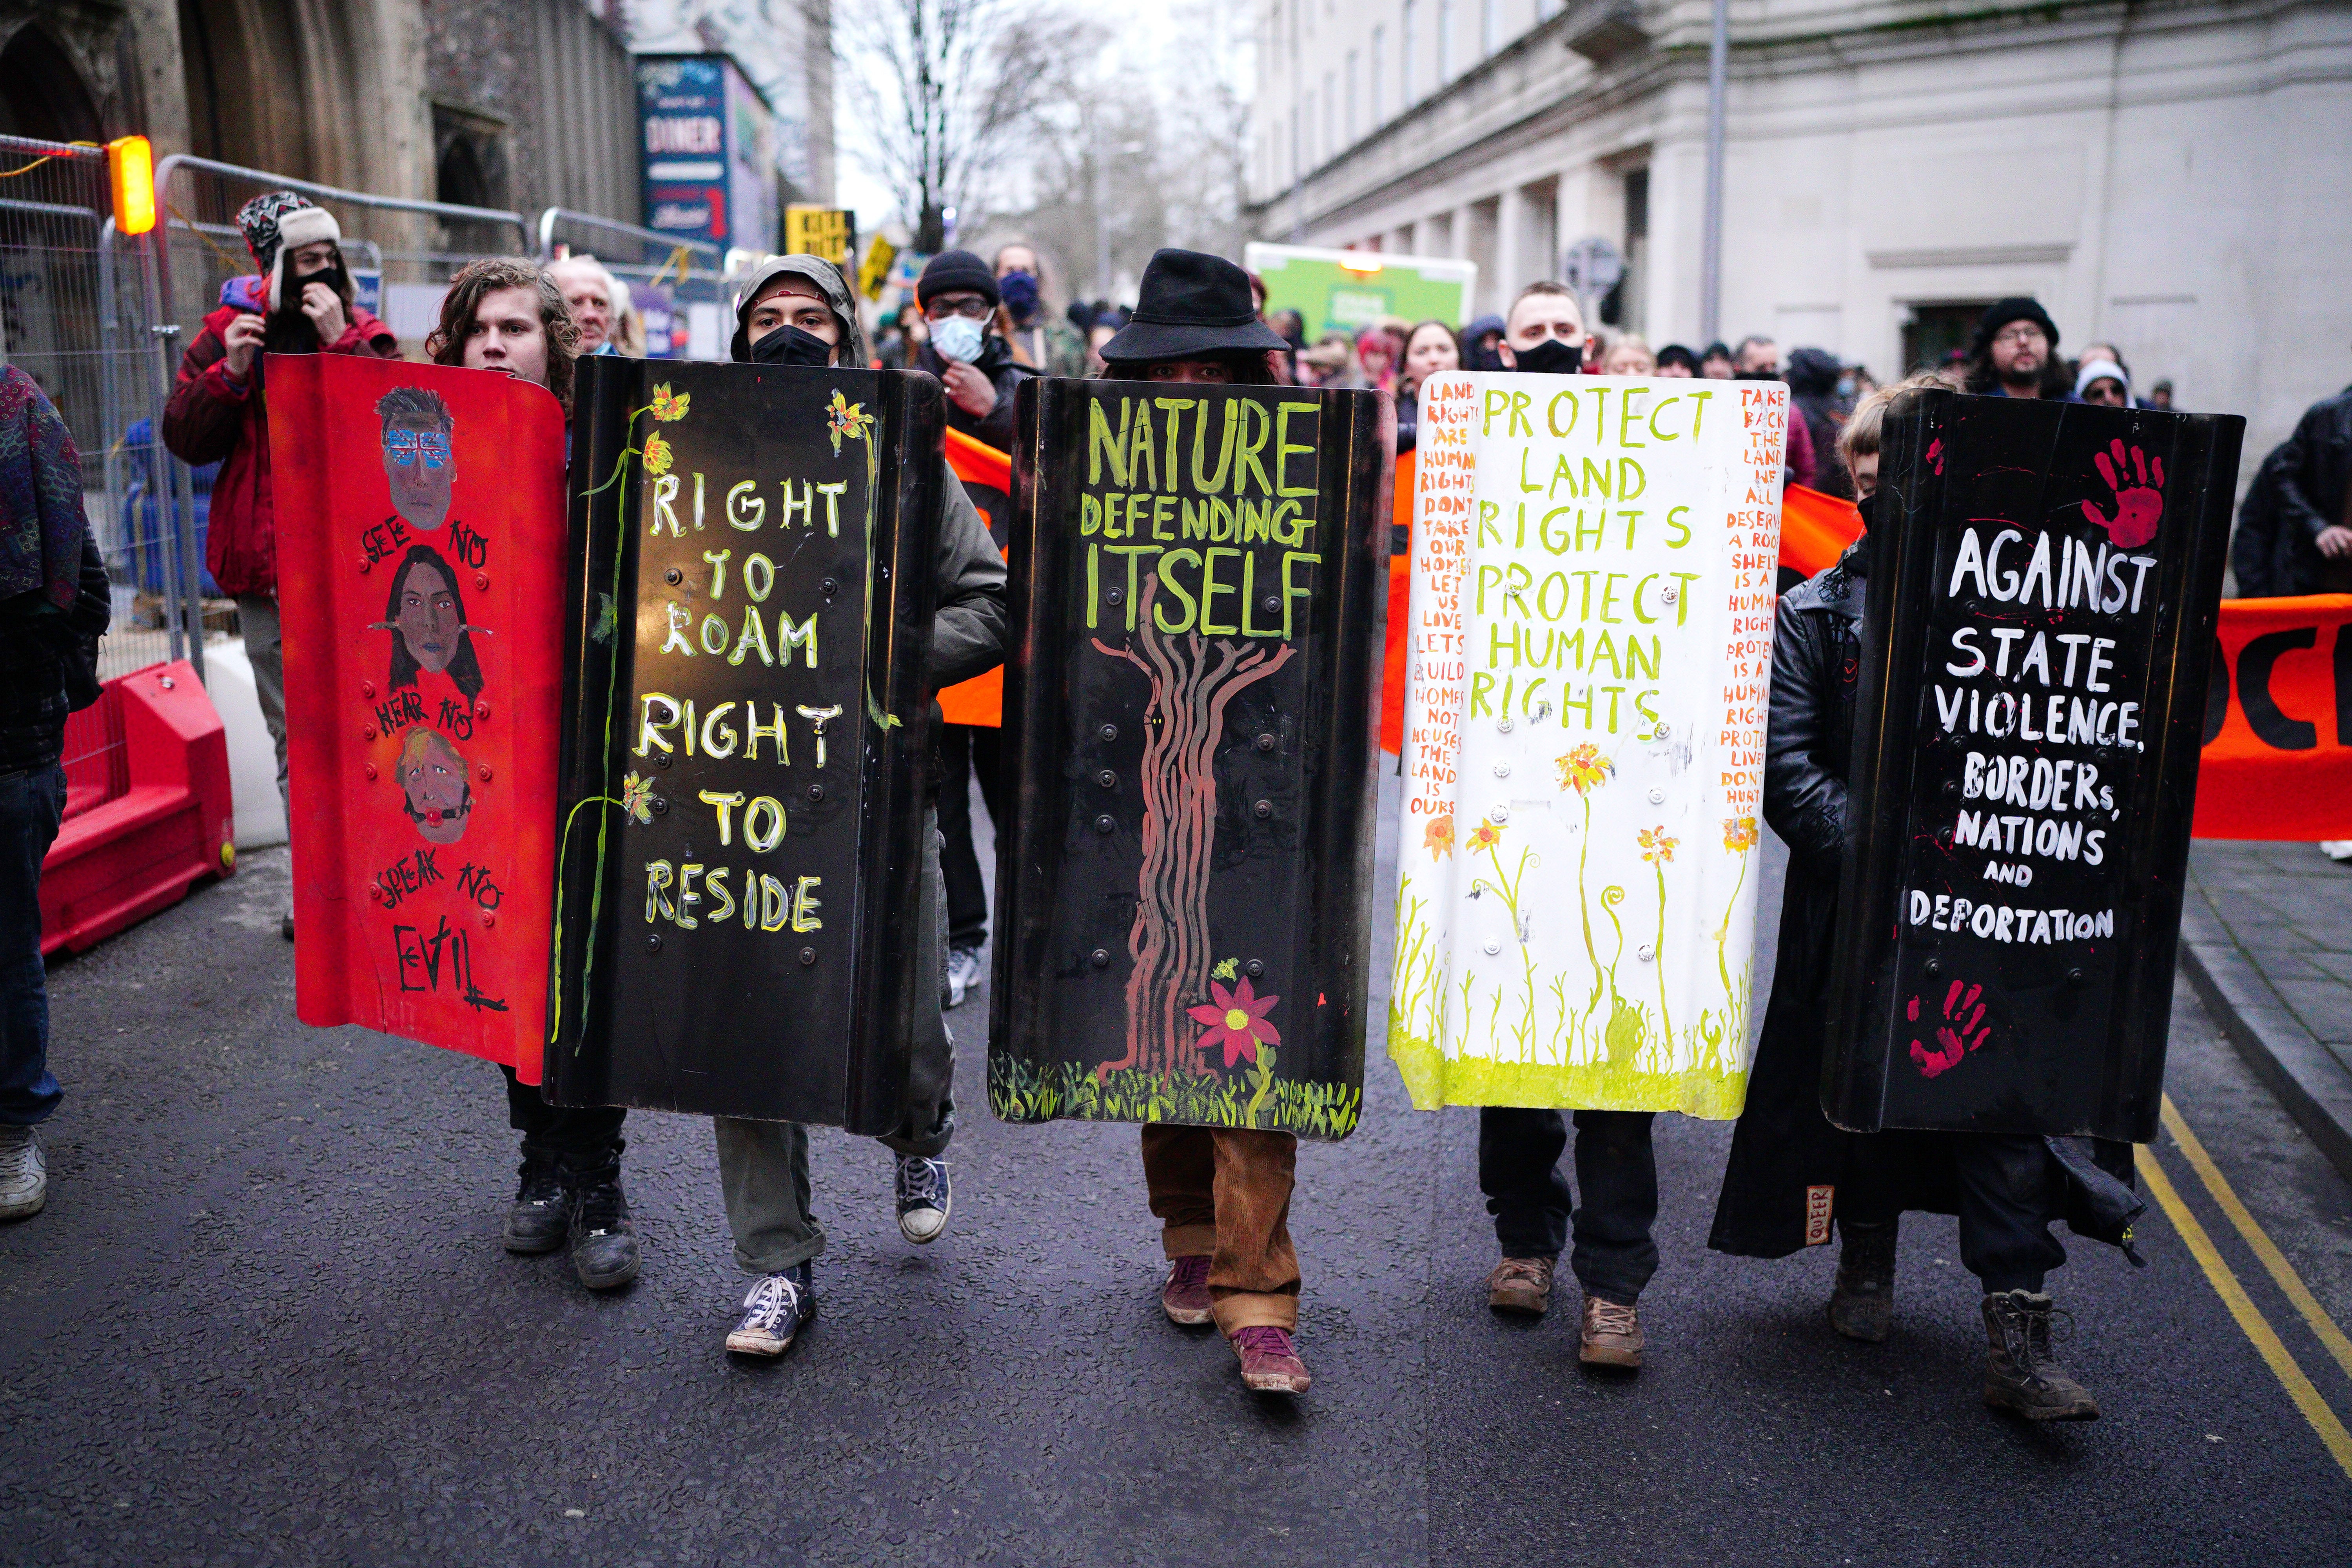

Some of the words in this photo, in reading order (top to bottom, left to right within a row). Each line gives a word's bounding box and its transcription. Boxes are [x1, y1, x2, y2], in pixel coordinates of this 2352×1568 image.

[1430, 381, 1475, 401] LAND
[1740, 389, 1785, 407] TAKE
[1427, 403, 1478, 424] RIGHTS
[1483, 387, 1713, 448] PROTECT
[1744, 412, 1784, 428] BACK
[1089, 397, 1321, 497] NATURE
[1434, 426, 1467, 447] ARE
[1750, 432, 1780, 448] THE
[1425, 450, 1476, 471] HUMAN
[1744, 449, 1781, 466] LAND
[1420, 472, 1475, 494] RIGHTS
[1520, 446, 1647, 503] LAND
[1755, 469, 1776, 484] WE
[650, 472, 847, 538] RIGHT
[1425, 496, 1472, 516] DONT
[1746, 487, 1773, 505] ALL
[1081, 492, 1317, 548] DEFENDING
[1422, 518, 1469, 537] TAKE
[1477, 499, 1691, 556] RIGHTS
[1727, 510, 1780, 530] DESERVE
[362, 515, 411, 563] SEE
[448, 519, 488, 569] NO
[1430, 539, 1466, 555] OUR
[1729, 534, 1742, 548] A
[703, 549, 775, 602] TO
[1420, 557, 1472, 575] HOMES
[1949, 527, 2157, 615] AGAINST
[1431, 574, 1461, 593] LET
[1735, 572, 1750, 590] IS
[1759, 571, 1769, 587] A
[1086, 543, 1321, 641] ITSELF
[1476, 562, 1702, 628] PROTECT
[1729, 593, 1774, 612] HUMAN
[1438, 595, 1458, 611] US
[1423, 610, 1462, 630] LIVE
[1733, 616, 1772, 635] RIGHT
[659, 601, 818, 668] ROAM
[1417, 634, 1465, 655] LETS
[1489, 621, 1661, 680] HUMAN
[1946, 627, 2116, 692] STATE
[1734, 662, 1748, 679] IS
[1755, 661, 1763, 679] A
[1416, 687, 1464, 710] HOMES
[1724, 683, 1769, 704] HUMAN
[375, 691, 429, 738] HEAR
[437, 696, 474, 740] NO
[1471, 671, 1662, 740] RIGHTS
[1726, 707, 1767, 725] RIGHT
[1428, 708, 1459, 730] NOT
[1935, 684, 2144, 753] VIOLENCE,
[632, 692, 843, 768] RIGHT
[1412, 727, 1461, 755] HOUSES
[1420, 745, 1450, 766] THE
[1731, 751, 1764, 769] LIVES
[1412, 761, 1456, 784] LAND
[1721, 771, 1763, 786] DONT
[1426, 783, 1439, 796] IS
[1727, 789, 1760, 804] HURT
[1411, 798, 1454, 815] OURS
[1736, 805, 1753, 817] US
[698, 789, 787, 853] TO
[1955, 809, 2105, 866] NATIONS
[377, 848, 444, 909] SPEAK
[457, 862, 504, 909] NO
[1984, 860, 2033, 887] AND
[645, 859, 823, 933] RESIDE
[1910, 889, 2114, 944] DEPORTATION
[393, 915, 509, 1012] EVIL
[1810, 1189, 1829, 1238] QUEER
